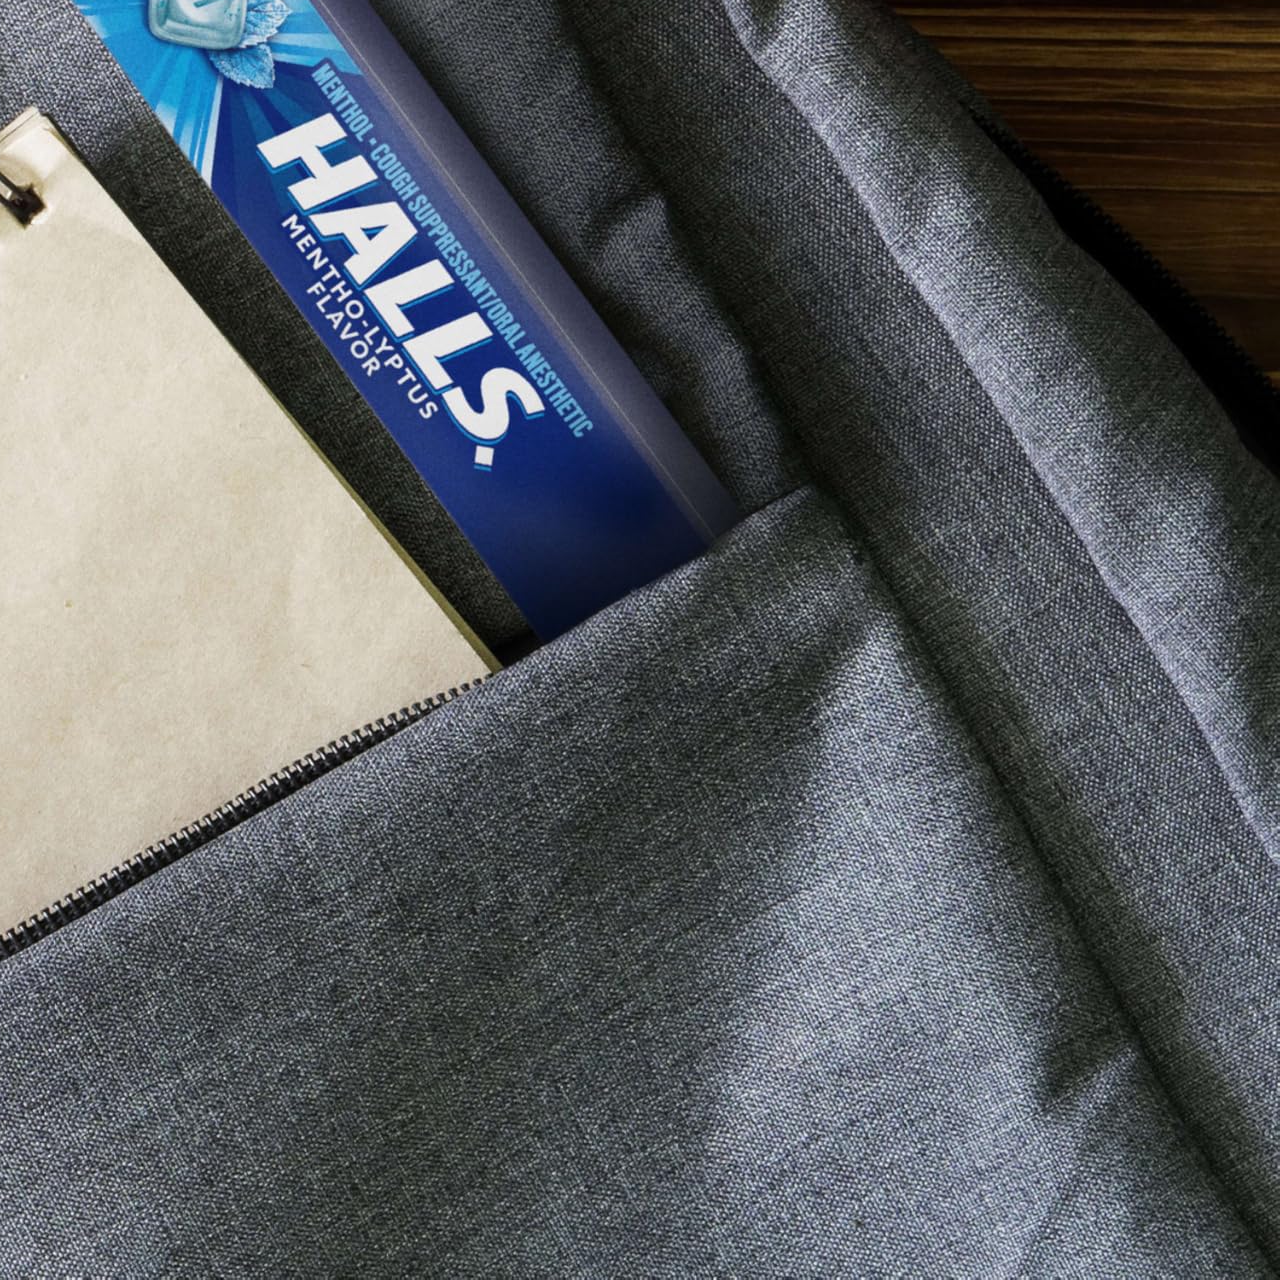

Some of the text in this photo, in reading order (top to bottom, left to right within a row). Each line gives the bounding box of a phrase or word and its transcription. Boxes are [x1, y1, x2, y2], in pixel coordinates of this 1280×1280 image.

[281, 214, 438, 419] MENTHO-LYPTUS
[307, 282, 380, 376] FLAVOR
[311, 63, 593, 438] MENTHOL COUGH SUPPRESSANT/ORAL ANESTHETIC
